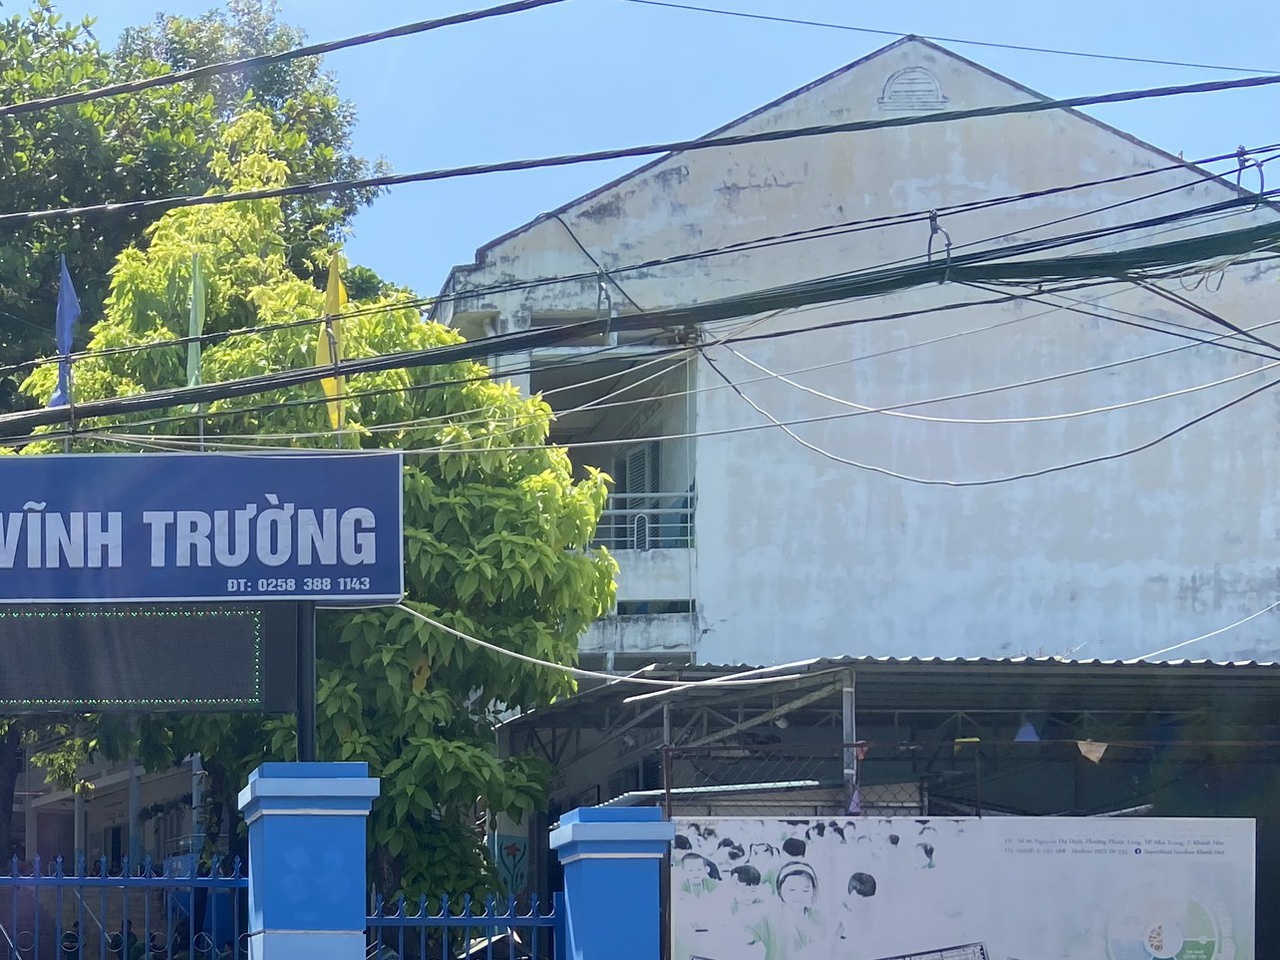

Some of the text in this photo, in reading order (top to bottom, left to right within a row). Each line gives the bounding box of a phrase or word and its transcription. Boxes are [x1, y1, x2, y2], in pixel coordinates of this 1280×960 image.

[143, 493, 377, 568] TRƯỜNG
[227, 577, 370, 592] ĐT: 0258 388 1143
